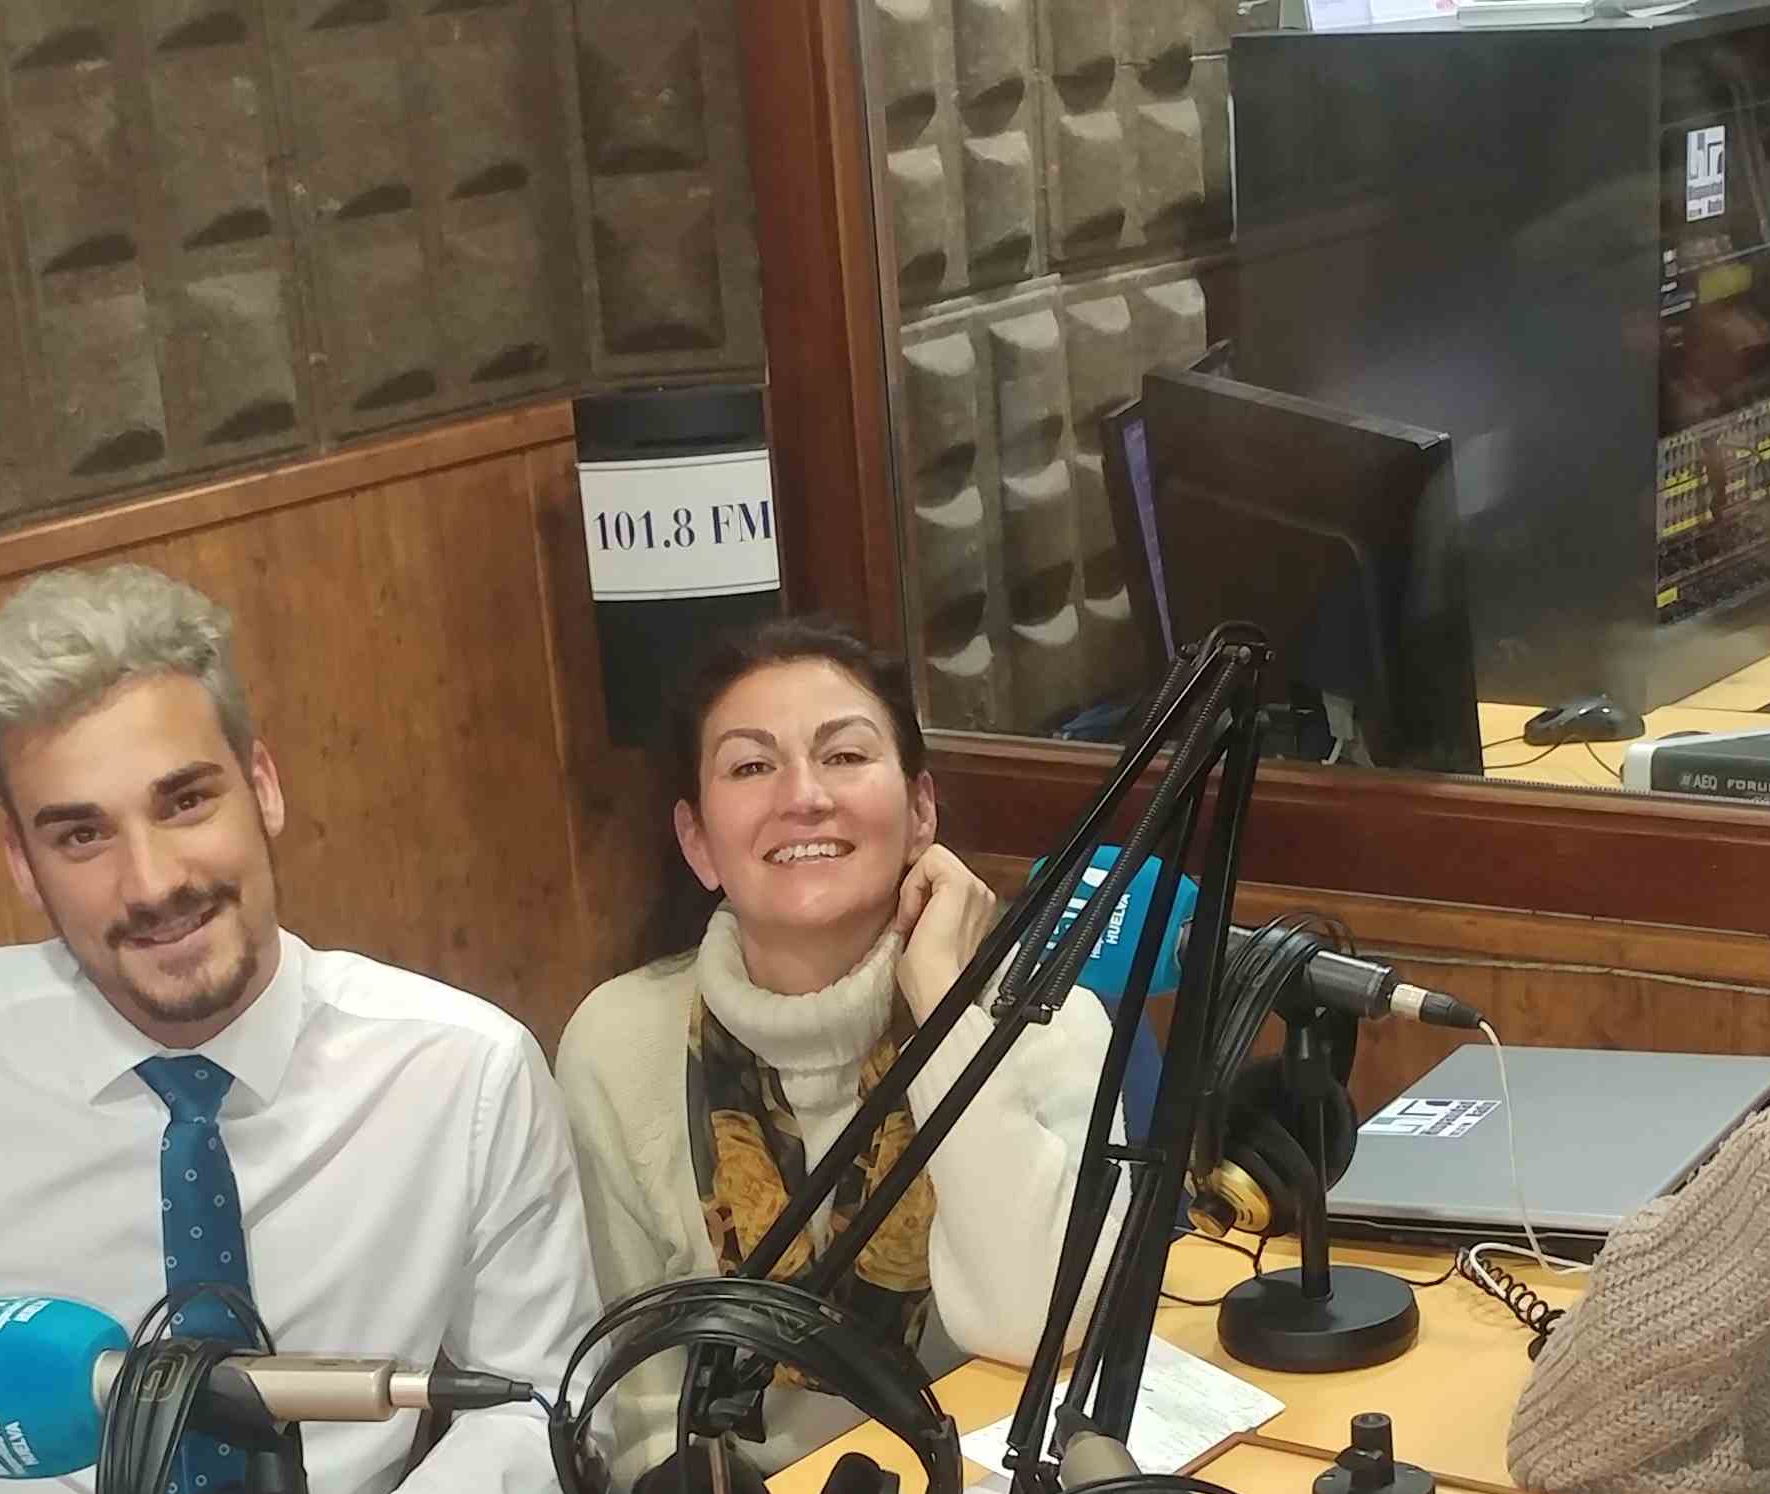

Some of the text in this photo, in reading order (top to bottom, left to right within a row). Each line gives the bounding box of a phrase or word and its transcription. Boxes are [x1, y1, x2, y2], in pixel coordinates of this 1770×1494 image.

[593, 500, 772, 551] 101.8 FM
[1693, 774, 1718, 790] AEQ
[1105, 893, 1131, 945] HUELVA
